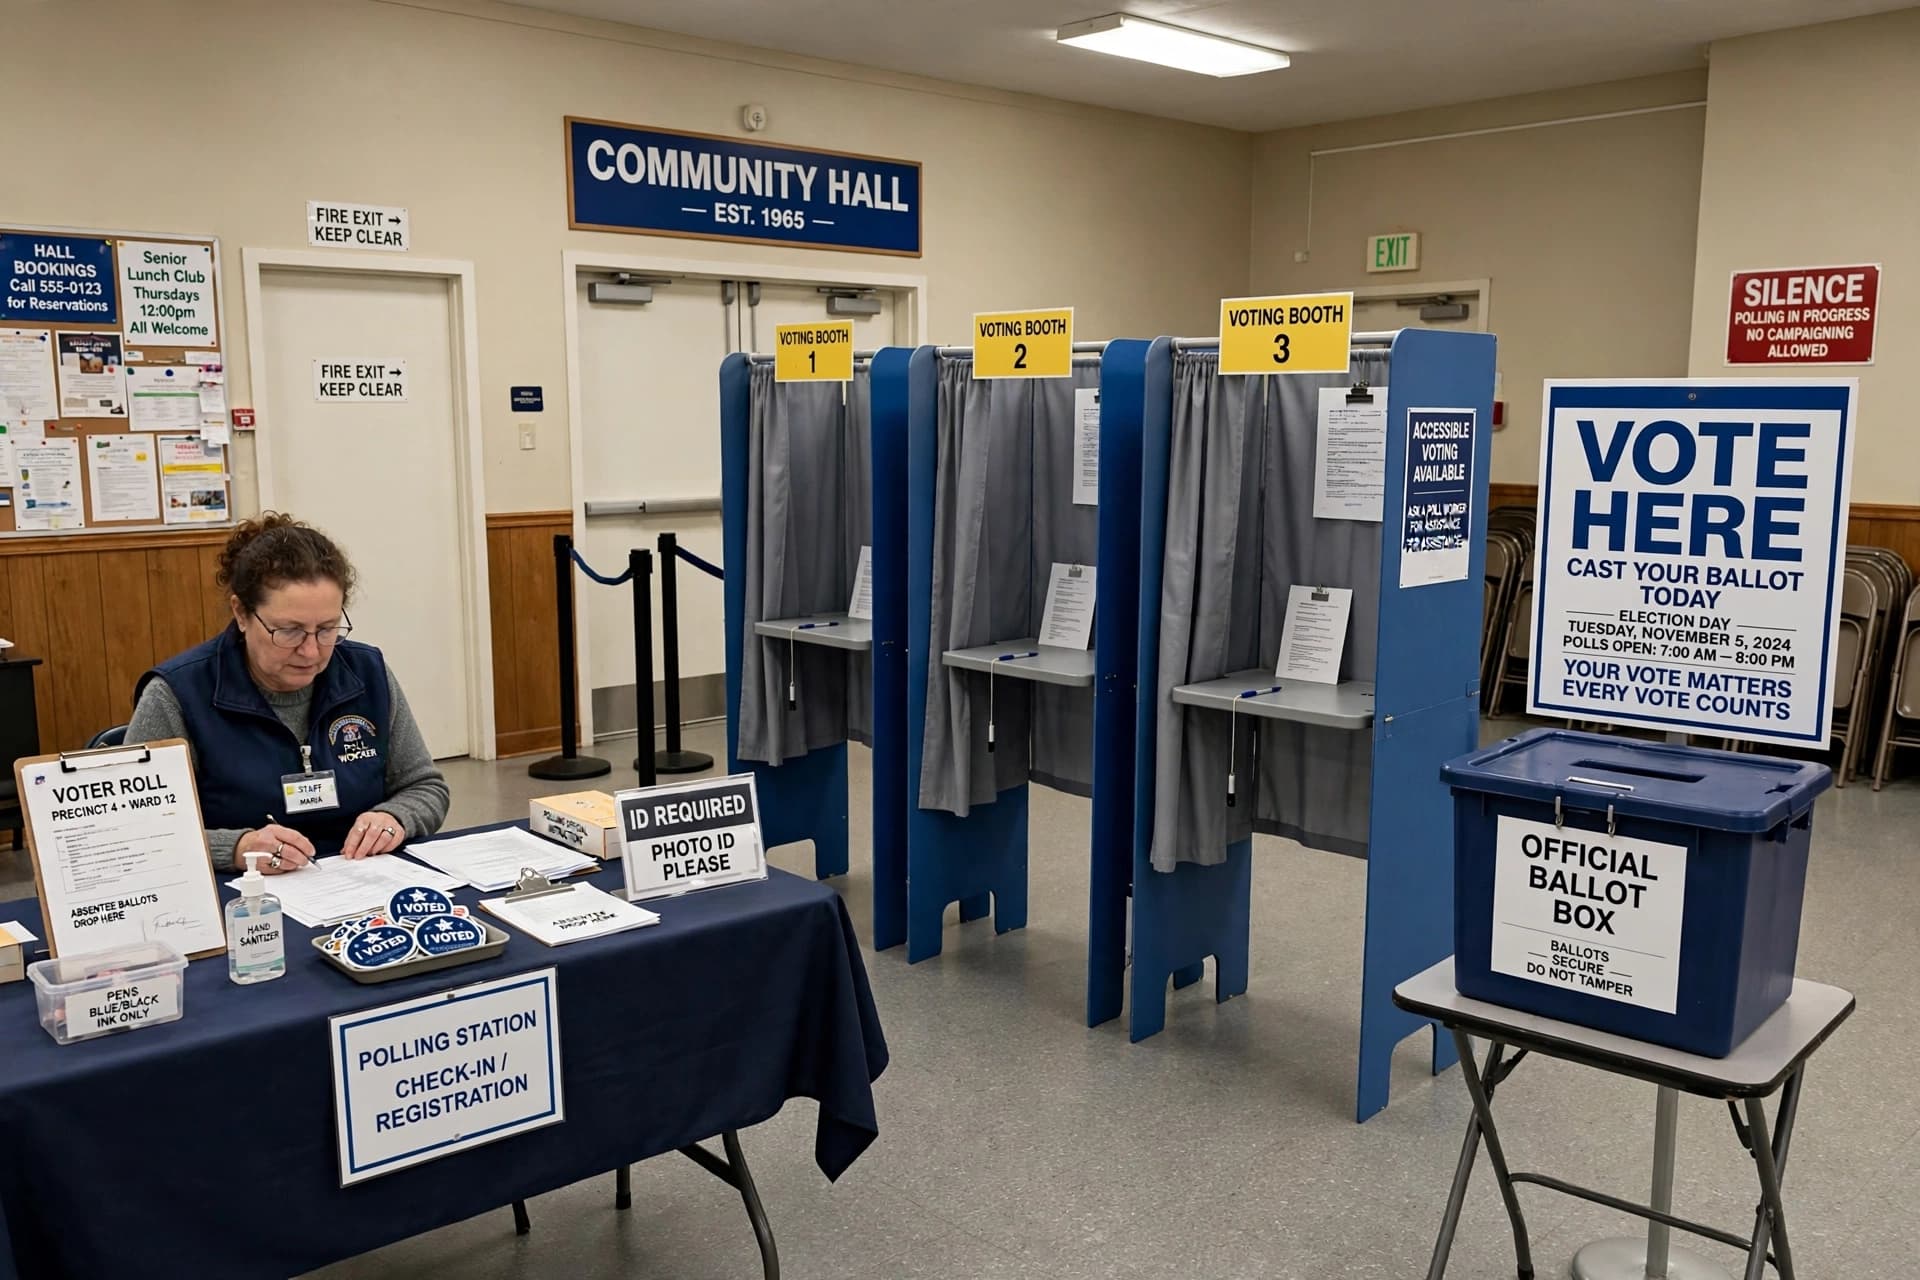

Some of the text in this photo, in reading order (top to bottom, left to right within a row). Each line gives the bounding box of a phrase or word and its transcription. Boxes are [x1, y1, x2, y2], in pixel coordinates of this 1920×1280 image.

[587, 139, 908, 212] COMMUNITY HALL
[316, 207, 383, 226] FIRE EXIT
[714, 202, 805, 230] EST. 1965
[315, 226, 402, 246] KEEP CLEAR
[34, 244, 75, 259] HALL
[143, 251, 187, 265] Senior
[1375, 236, 1410, 268] EXIT
[14, 261, 97, 277] BOOKINGS
[128, 267, 205, 283] Lunch Club
[10, 279, 101, 295] Call 555-0123
[133, 286, 199, 303] Thursdays
[1743, 274, 1865, 307] SILENCE
[7, 296, 108, 312] for Reservations
[140, 304, 195, 321] 12:00pm
[1229, 305, 1344, 327] VOTING BOOTH
[1735, 307, 1870, 325] POLLING IN PROGRESS
[130, 321, 208, 335] All Welcome
[780, 329, 849, 345] VOTING BOOTH
[980, 318, 1066, 338] VOTING BOOTH
[1747, 326, 1854, 341] NO CAMPAIGNING
[1014, 343, 1027, 369] 2
[1272, 333, 1290, 363] 3
[1767, 344, 1828, 357] ALLOWED
[321, 364, 385, 379] FIRE EXIT
[808, 350, 816, 373] 1
[320, 382, 402, 396] KEEP CLEAR
[1413, 421, 1470, 440] ACCESSIBLE
[1422, 443, 1458, 461] VOTING
[1576, 420, 1811, 489] VOTE
[1413, 463, 1465, 483] AVAILABLE
[1572, 490, 1805, 562] HERE
[1567, 558, 1803, 592] CAST YOUR BALLOT
[1640, 585, 1721, 609] TODAY
[1619, 610, 1731, 631] ELECTION DAY
[1568, 620, 1791, 651] TUESDAY, NOVEMBER 5, 2024
[1563, 636, 1609, 651] POLLS
[1612, 639, 1657, 656] OPEN:
[1661, 644, 1690, 659] 7:00
[1694, 648, 1717, 662] AM
[1735, 652, 1767, 666] 8:00
[1771, 655, 1795, 668] PM
[1563, 658, 1792, 698] YOUR VOTE MATTERS
[1562, 679, 1791, 720] EVERY VOTE COUNTS
[52, 774, 167, 804] VOTER ROLL
[297, 783, 322, 793] STAFF
[52, 804, 108, 821] PRECINCT
[111, 803, 118, 812] 4
[129, 796, 161, 810] WARD
[165, 794, 176, 804] 12
[629, 794, 746, 830] ID REQUIRED
[652, 832, 735, 861] PHOTO ID
[1521, 834, 1658, 881] OFFICIAL
[663, 854, 731, 880] PLEASE
[1529, 865, 1647, 909] BALLOT
[71, 894, 158, 918] ABSENTEE BALLOTS
[396, 903, 446, 913] I VOTED
[1553, 899, 1615, 935] BOX
[74, 911, 126, 929] DROP HERE
[248, 923, 270, 935] HAND
[355, 952, 363, 960] I
[362, 935, 407, 956] VOTED
[424, 931, 475, 945] I VOTED
[1551, 940, 1609, 962] BALLOTS
[1552, 954, 1604, 976] SECURE
[1527, 962, 1633, 997] DO NOT TAMPER
[107, 987, 139, 1001] PENS
[89, 994, 159, 1017] BLUE/BLACK
[97, 1008, 149, 1028] INK ONLY
[359, 1009, 537, 1071] POLLING STATION
[395, 1056, 496, 1098] CHECK-IN
[376, 1073, 528, 1133] REGISTRATION
